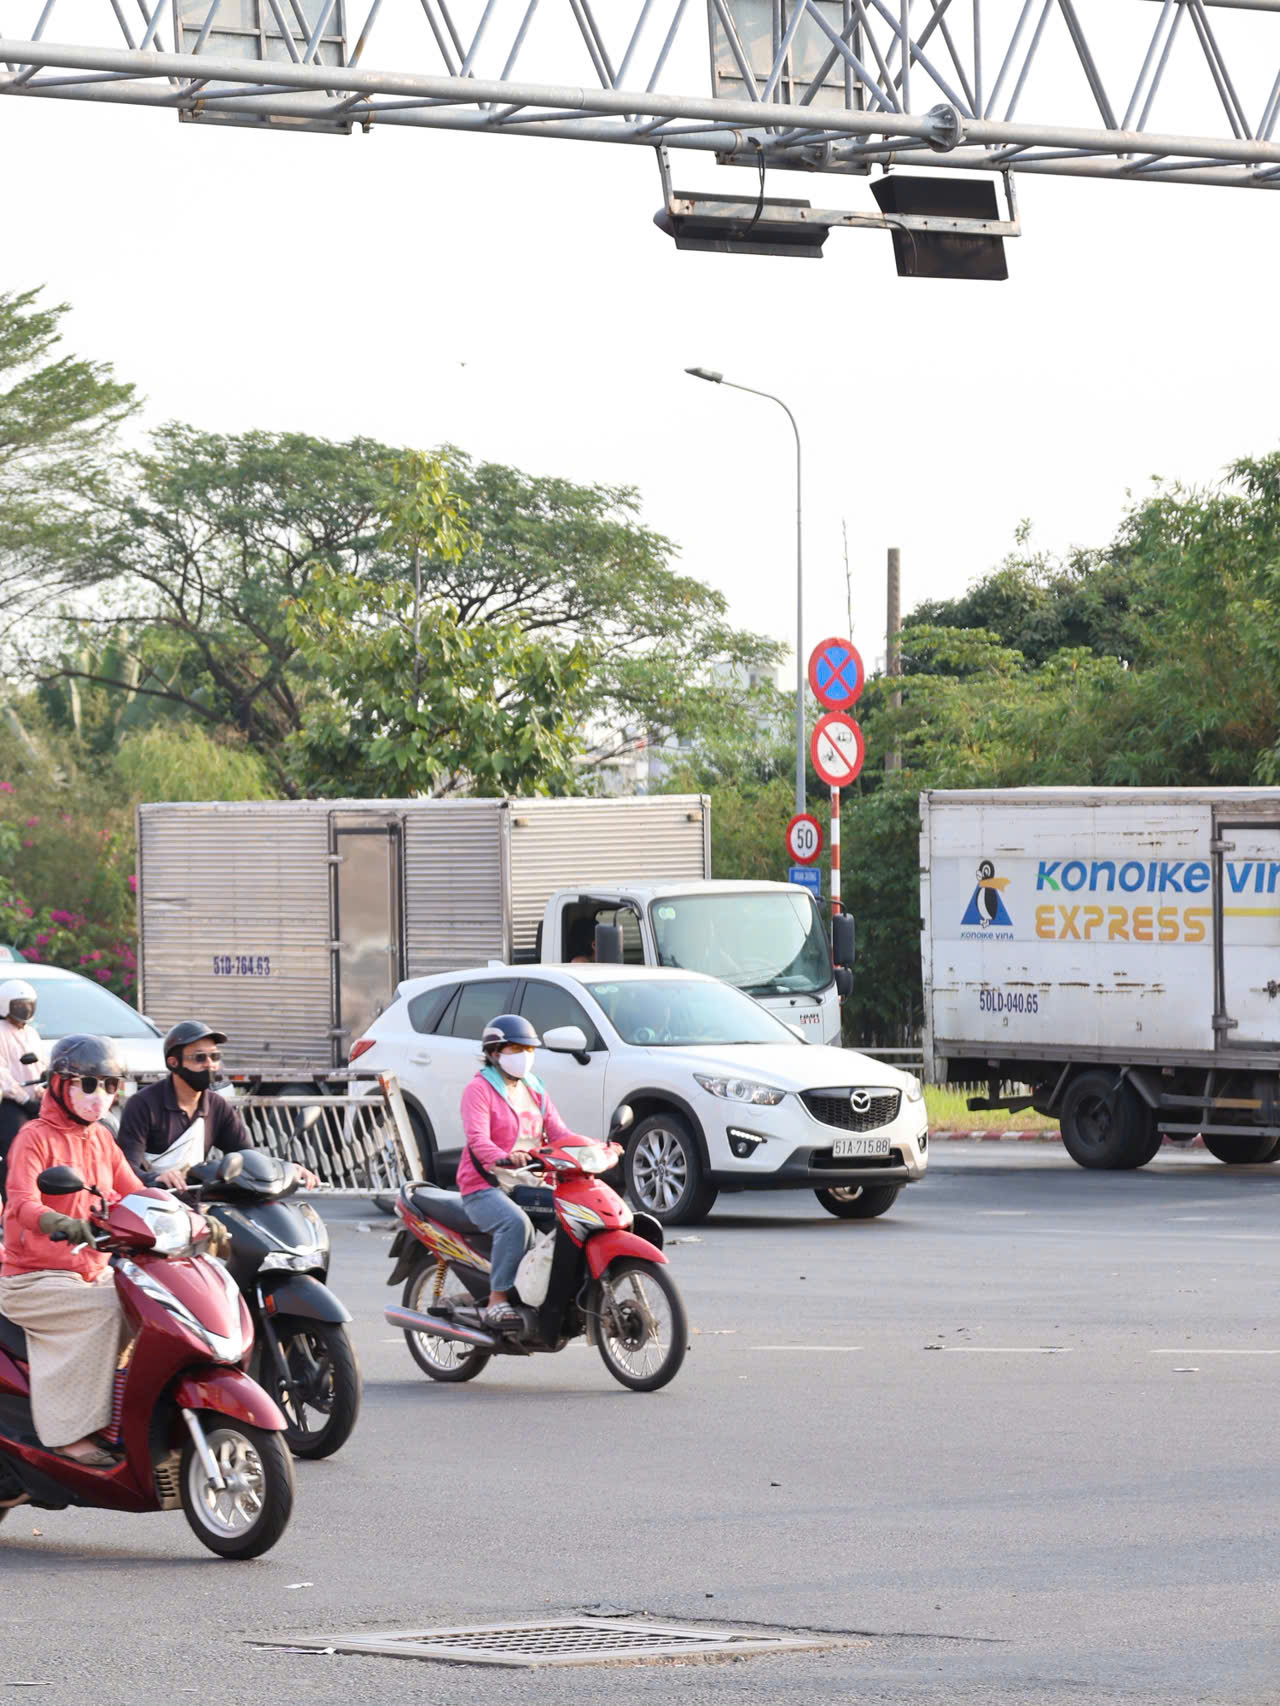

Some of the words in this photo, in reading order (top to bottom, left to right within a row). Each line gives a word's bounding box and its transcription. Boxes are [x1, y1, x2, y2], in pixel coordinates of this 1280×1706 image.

[797, 828, 813, 849] 50
[1035, 904, 1207, 942] EXPRESS
[980, 990, 1039, 1014] 50LD-040.65
